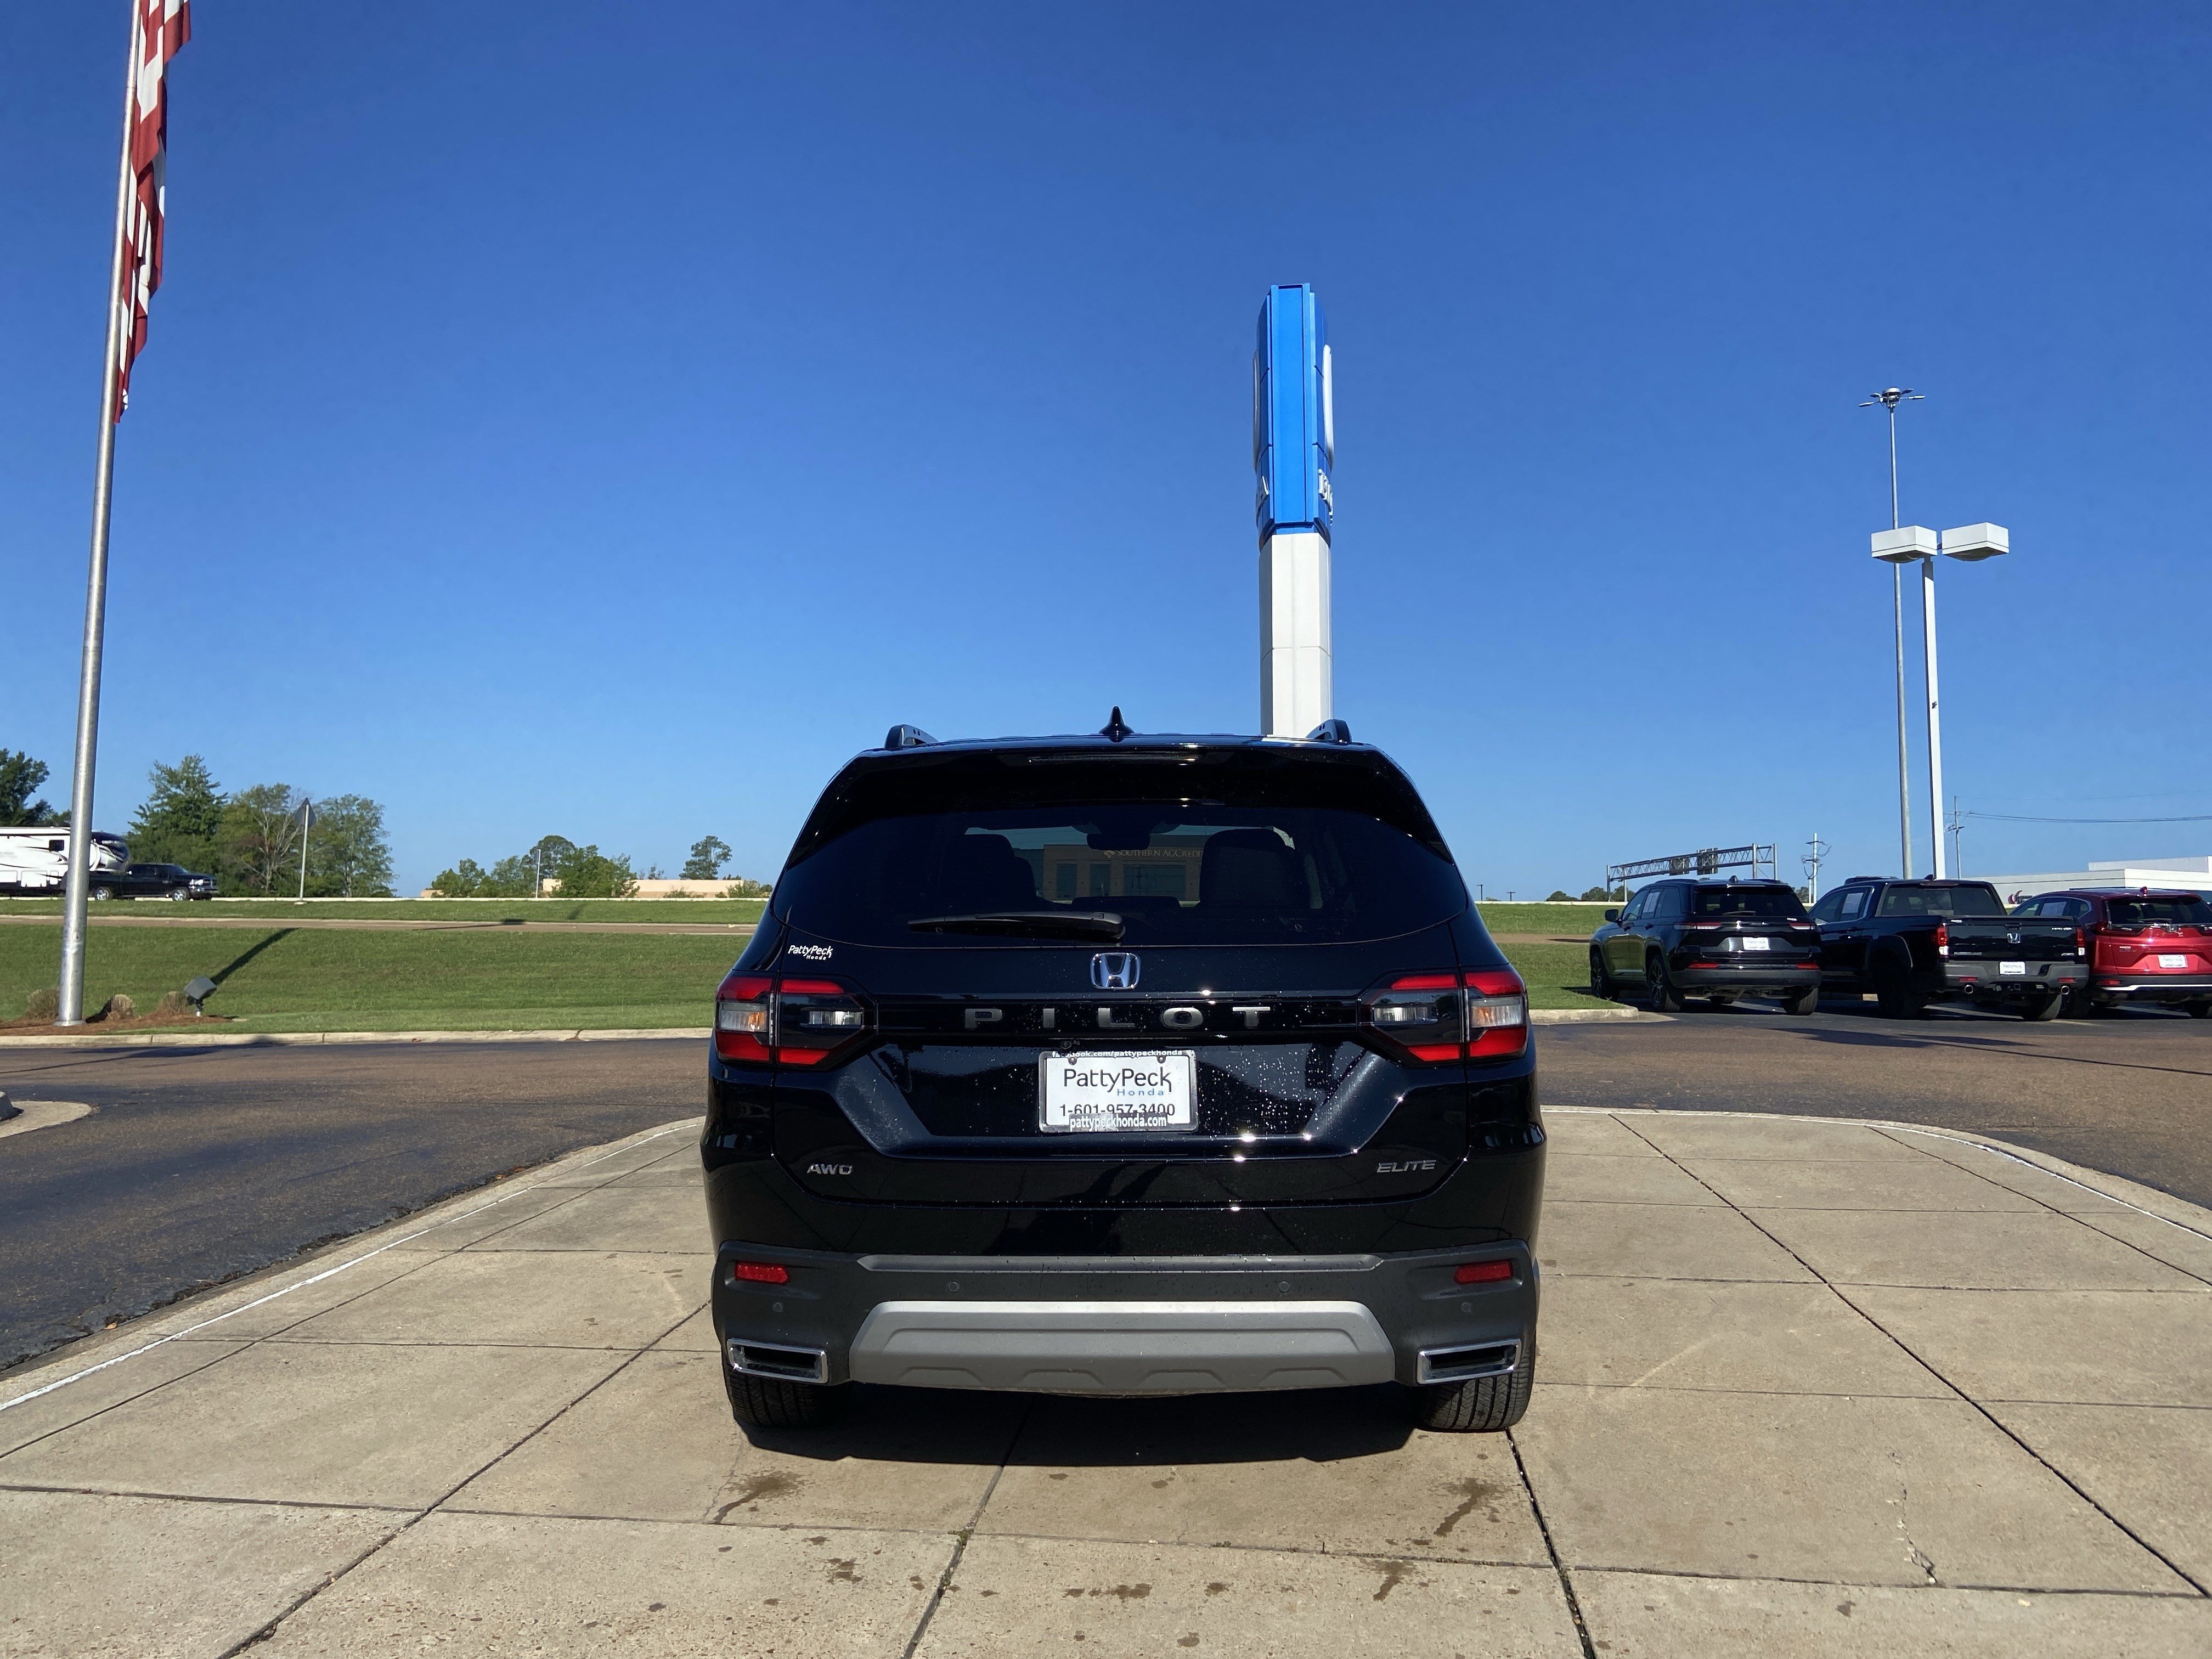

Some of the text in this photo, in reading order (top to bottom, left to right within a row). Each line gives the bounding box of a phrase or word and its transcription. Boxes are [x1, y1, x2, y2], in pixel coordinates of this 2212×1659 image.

[788, 945, 833, 958] PattyPeck
[964, 1006, 1271, 1029] PILOT
[1063, 1066, 1172, 1093] PattyPeck
[1116, 1087, 1165, 1096] Honda
[1059, 1103, 1176, 1116] 1-601-957-3400
[1070, 1113, 1167, 1132] pattypeckhonda.com
[806, 1164, 853, 1175] AWD
[1376, 1160, 1437, 1173] ELITE
